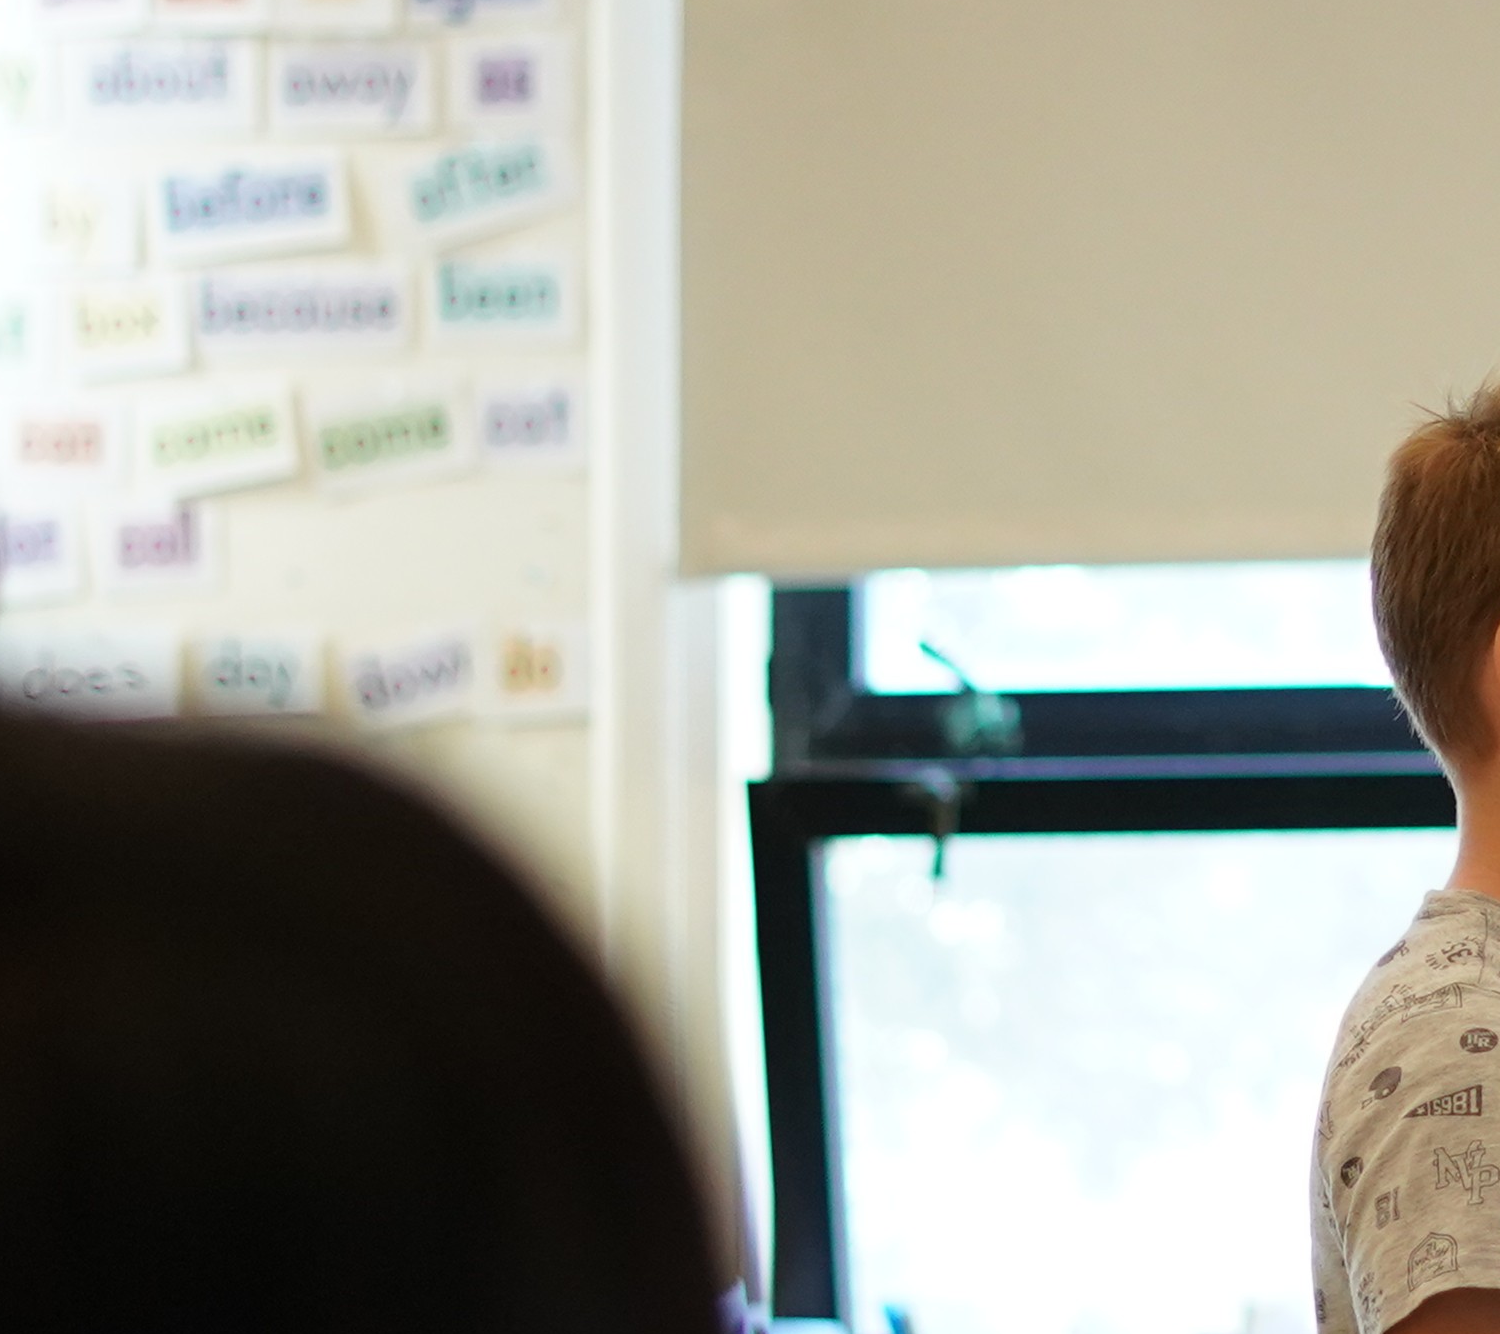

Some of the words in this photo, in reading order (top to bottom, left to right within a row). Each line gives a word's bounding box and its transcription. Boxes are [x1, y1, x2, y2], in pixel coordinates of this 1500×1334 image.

[90, 46, 229, 108] about
[283, 59, 415, 124] away
[164, 170, 330, 235] before
[411, 142, 547, 222] after
[200, 278, 399, 334] because
[438, 267, 560, 322] been
[22, 643, 150, 701] does
[213, 639, 293, 706] day
